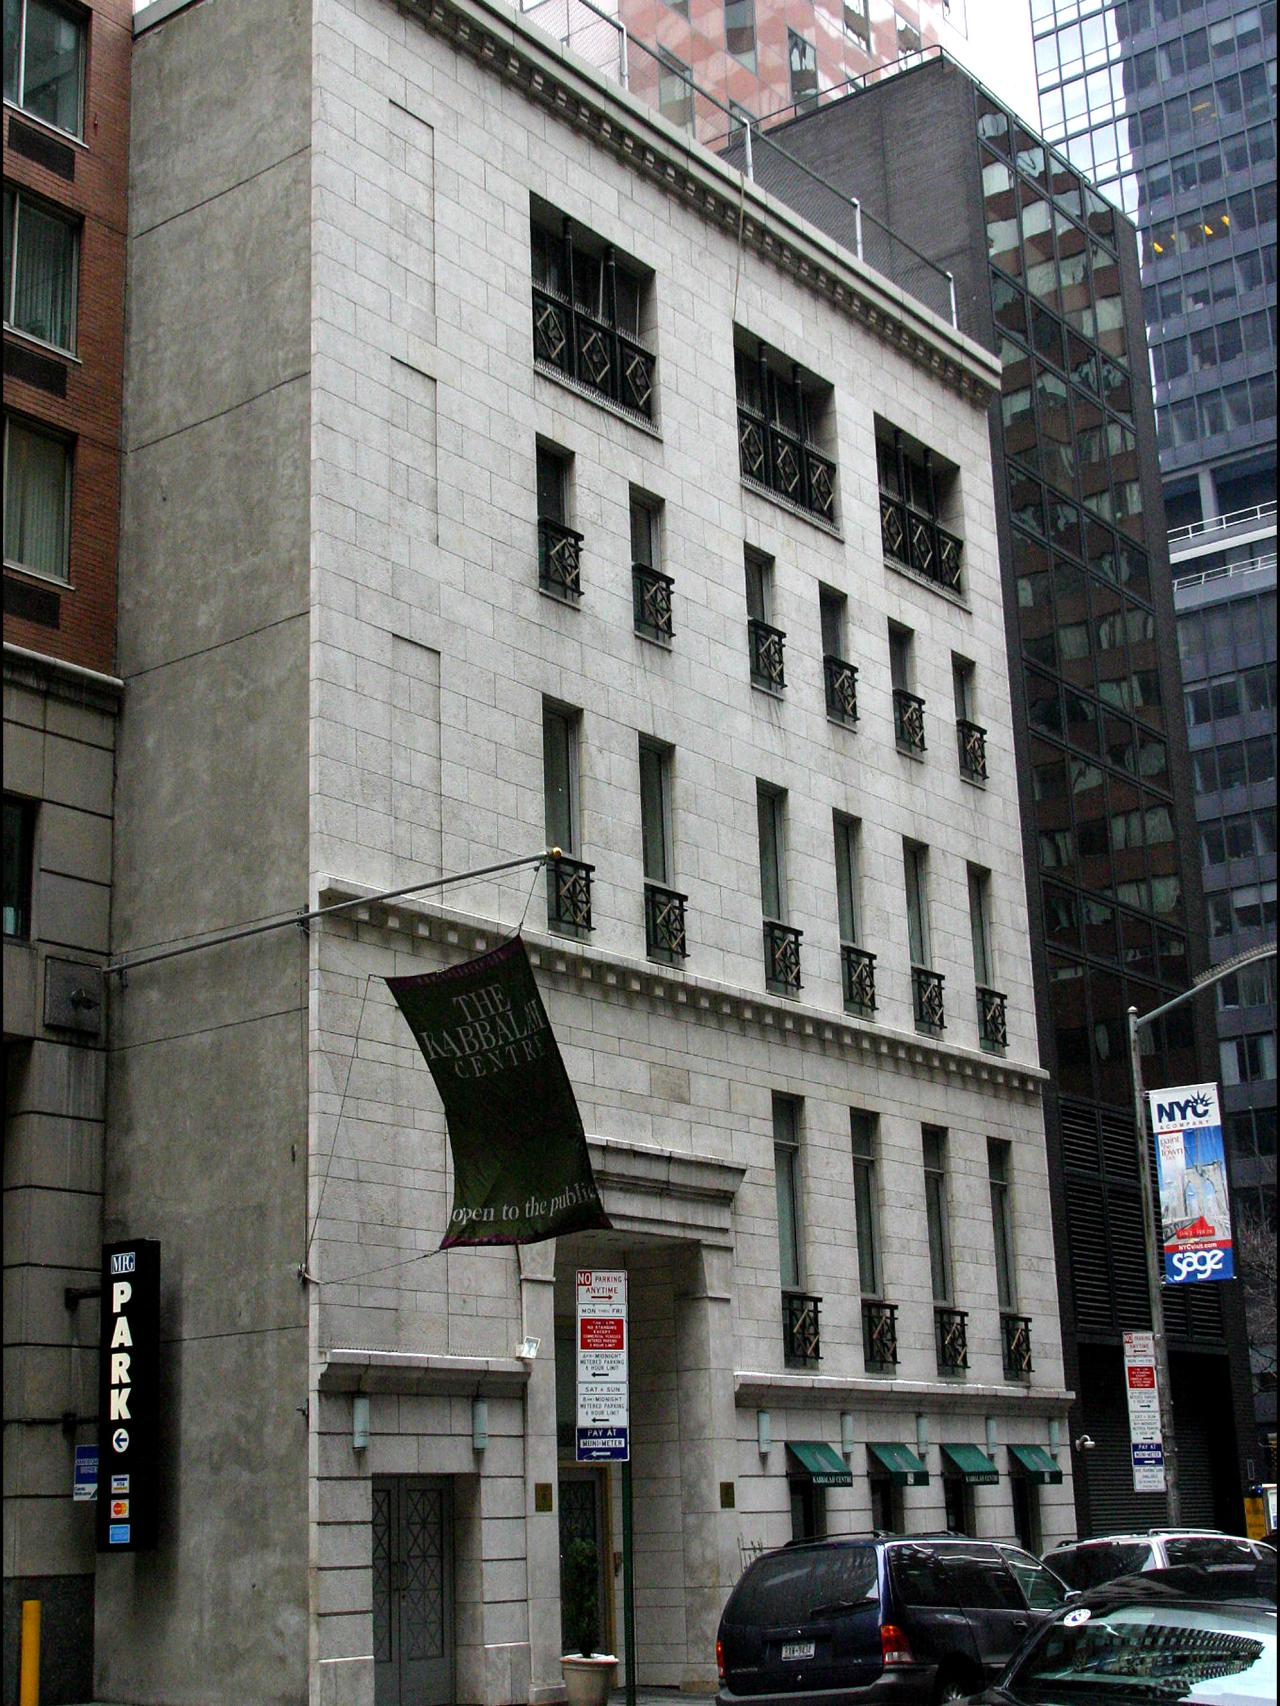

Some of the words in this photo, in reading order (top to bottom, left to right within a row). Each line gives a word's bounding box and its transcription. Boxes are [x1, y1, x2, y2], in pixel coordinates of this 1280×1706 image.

[451, 984, 512, 1023] THE
[1157, 1095, 1213, 1123] NYC
[452, 1206, 494, 1225] open
[502, 1203, 519, 1221] to
[525, 1196, 547, 1218] the
[549, 1182, 597, 1217] public
[577, 1272, 592, 1285] NO
[595, 1275, 622, 1283] PARKING
[1172, 1249, 1225, 1281] sage
[111, 1281, 133, 1420] PARK
[587, 1429, 604, 1437] PAY
[606, 1429, 617, 1437] AT
